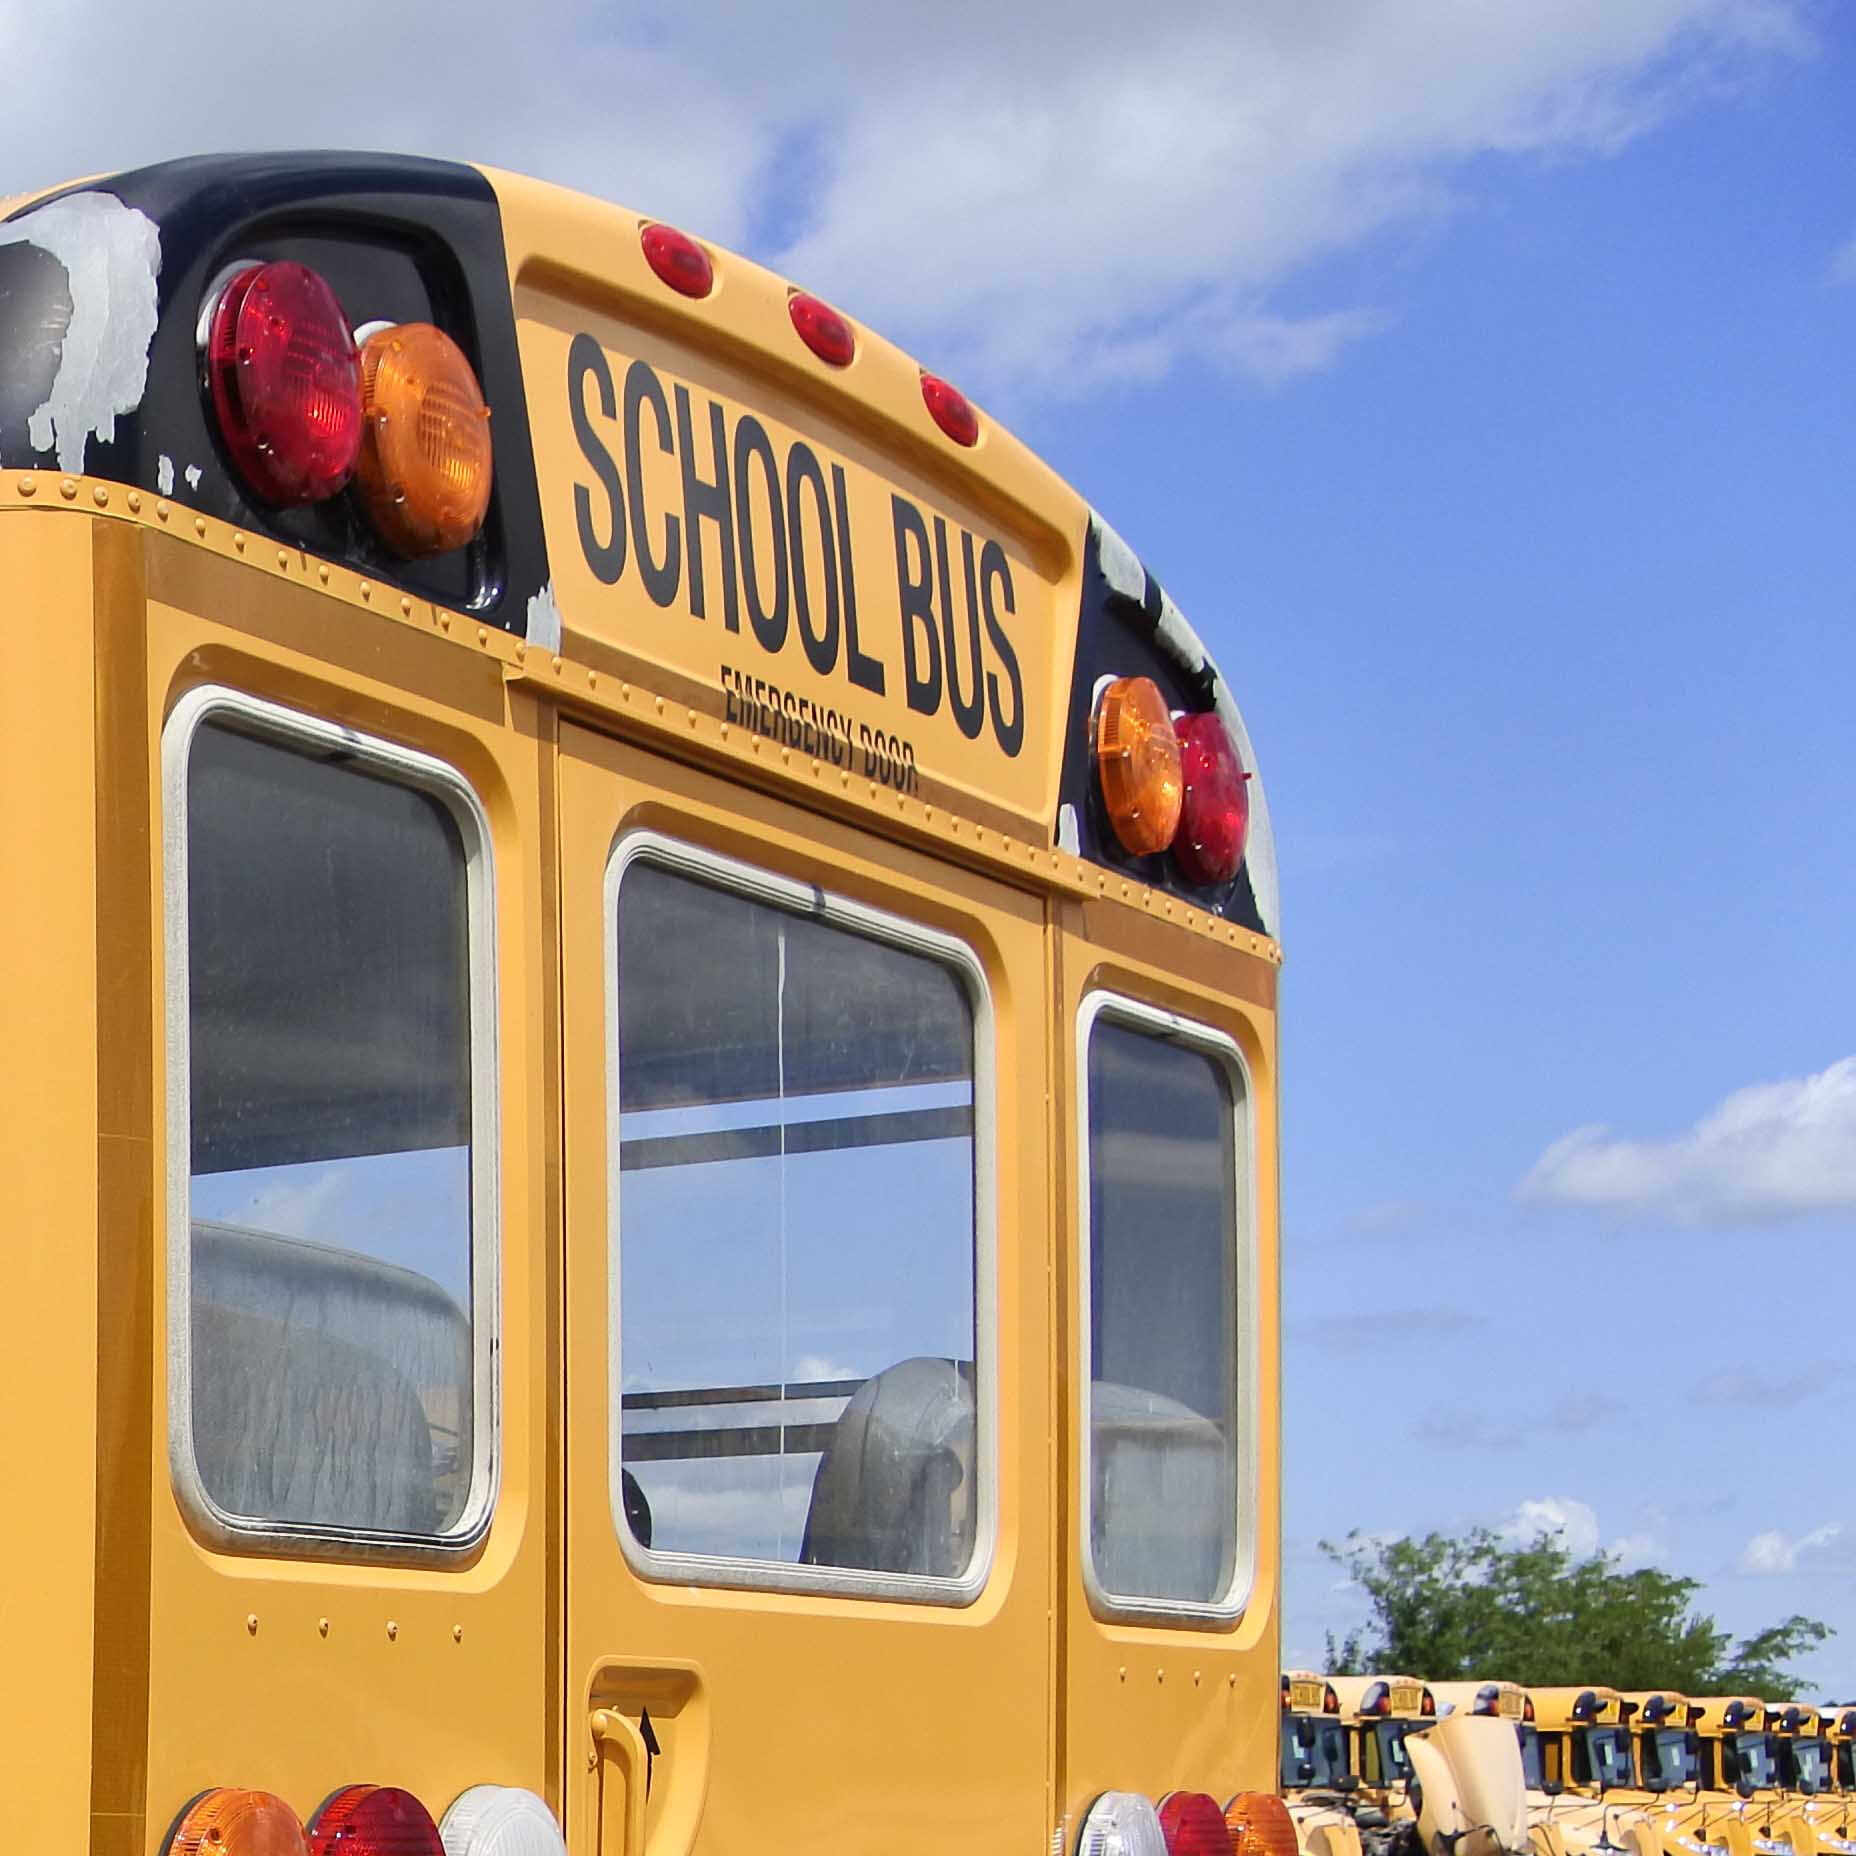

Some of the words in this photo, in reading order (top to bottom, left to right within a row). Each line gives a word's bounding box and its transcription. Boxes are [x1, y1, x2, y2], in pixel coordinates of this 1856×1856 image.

[568, 333, 886, 697] SCHOOL
[891, 493, 1025, 758] BUS
[720, 664, 853, 770] EMERGENCY
[860, 723, 919, 797] DOOR
